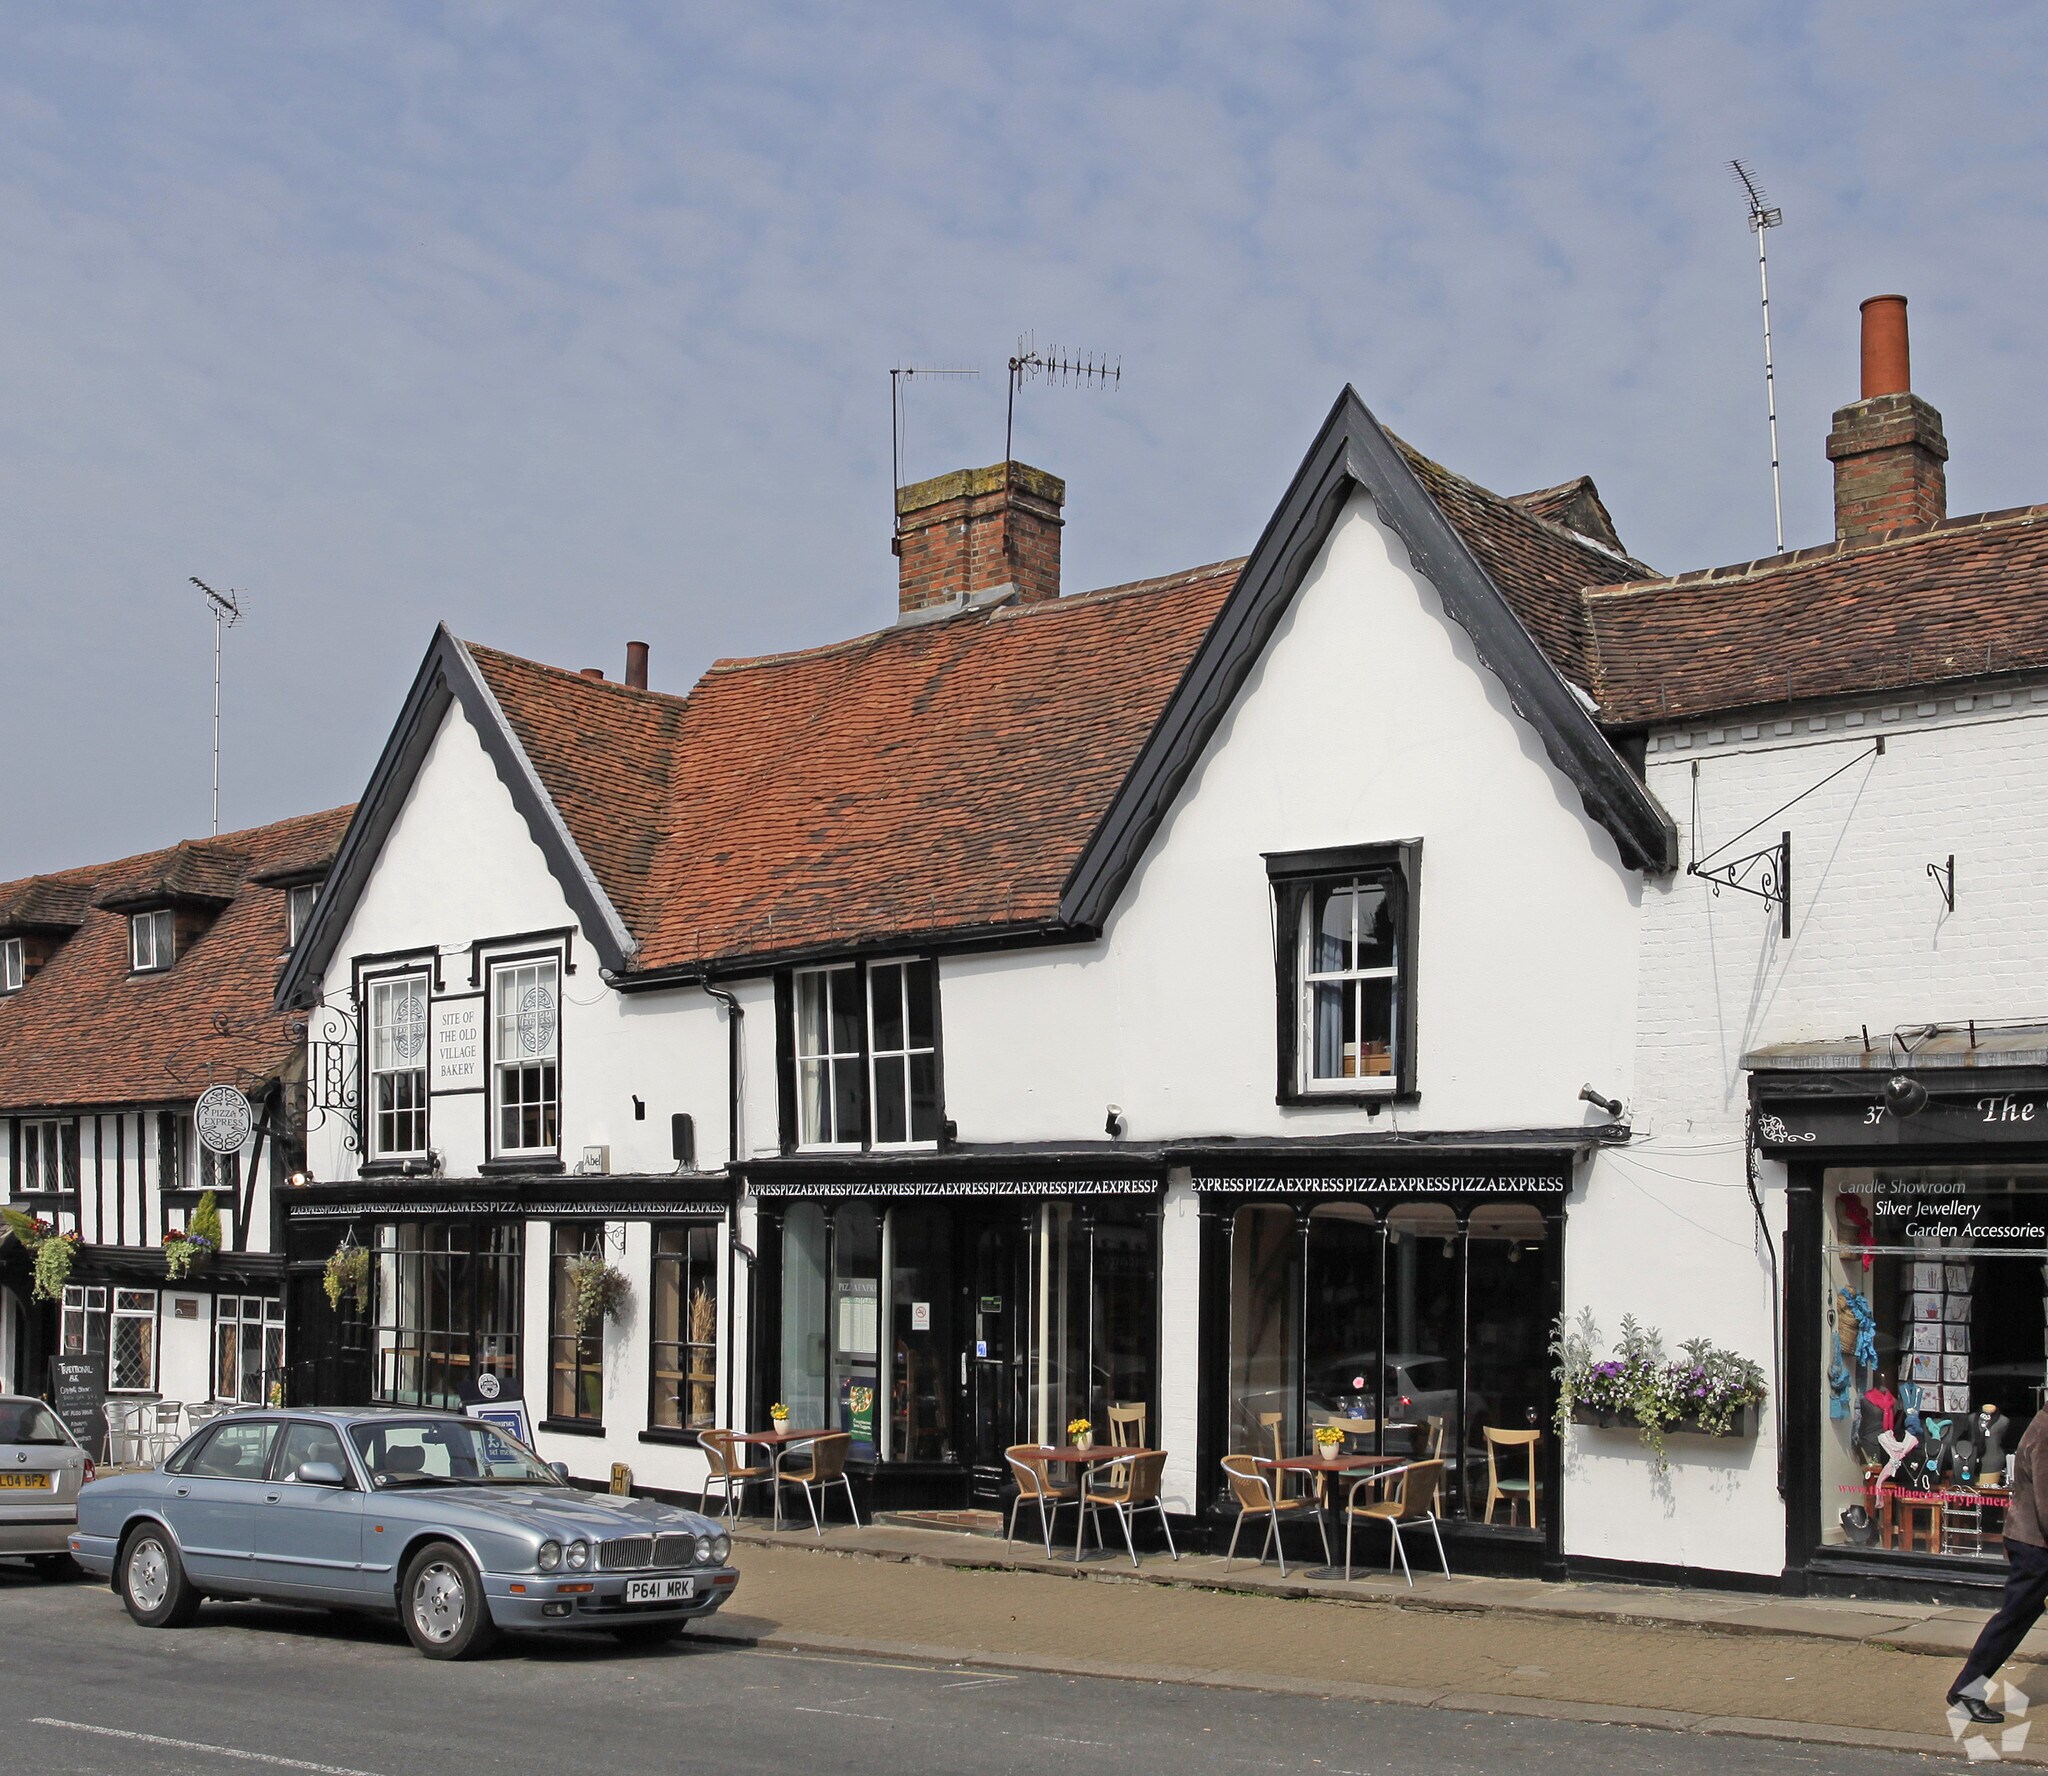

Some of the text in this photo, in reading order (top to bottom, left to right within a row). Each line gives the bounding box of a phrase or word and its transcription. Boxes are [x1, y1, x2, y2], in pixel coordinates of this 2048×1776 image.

[442, 1011, 474, 1026] SITE OF
[440, 1028, 477, 1043] THE OLD
[440, 1045, 476, 1060] VILLAGE
[441, 1062, 475, 1077] BAKERY
[211, 1109, 237, 1117] PIZZA
[1863, 1094, 2035, 1125] 37 The
[204, 1117, 244, 1127] EXPRESS
[584, 1154, 601, 1166] Abel
[1838, 1178, 1966, 1194] Candle Showroom
[1875, 1200, 1981, 1220] Silver Jewellery
[1905, 1221, 2046, 1238] Garden Accessories
[25, 1475, 46, 1487] BFZ
[632, 1580, 689, 1599] P641 MRK
